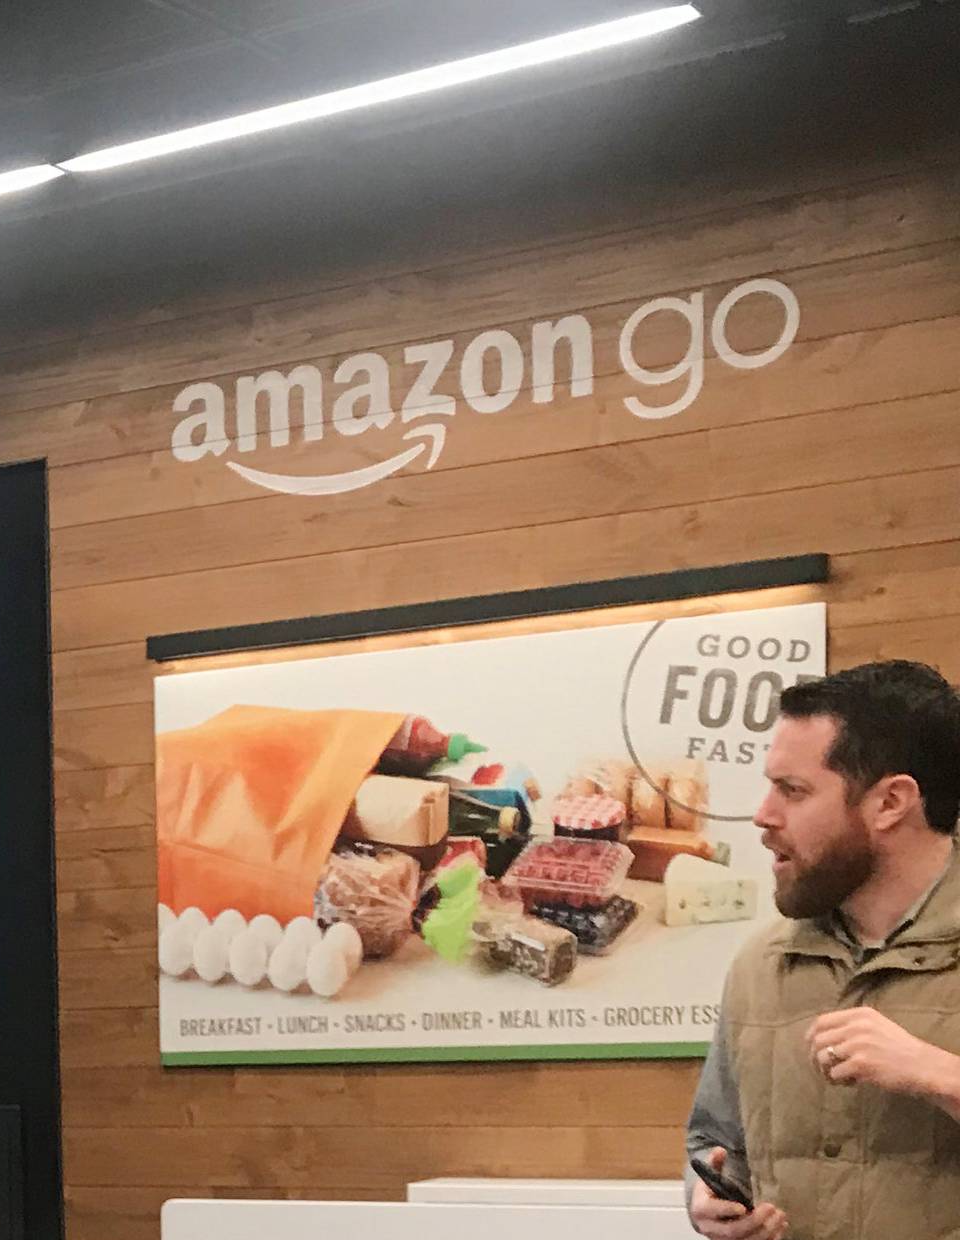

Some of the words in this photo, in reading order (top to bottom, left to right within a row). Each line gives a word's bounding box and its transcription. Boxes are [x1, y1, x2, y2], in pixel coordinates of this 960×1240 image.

[171, 313, 595, 463] amazon
[618, 277, 801, 420] go
[696, 634, 811, 663] GOOD
[659, 664, 826, 733] FOO
[685, 736, 772, 765] FAS
[179, 1016, 262, 1037] BREAKFAST
[277, 1015, 328, 1034] LUNCH
[345, 1013, 406, 1033] SNACKS
[422, 1011, 482, 1031] DINNER
[499, 1009, 541, 1029] MEAL
[549, 1008, 586, 1028] KITS
[604, 1006, 686, 1026] GROCERY
